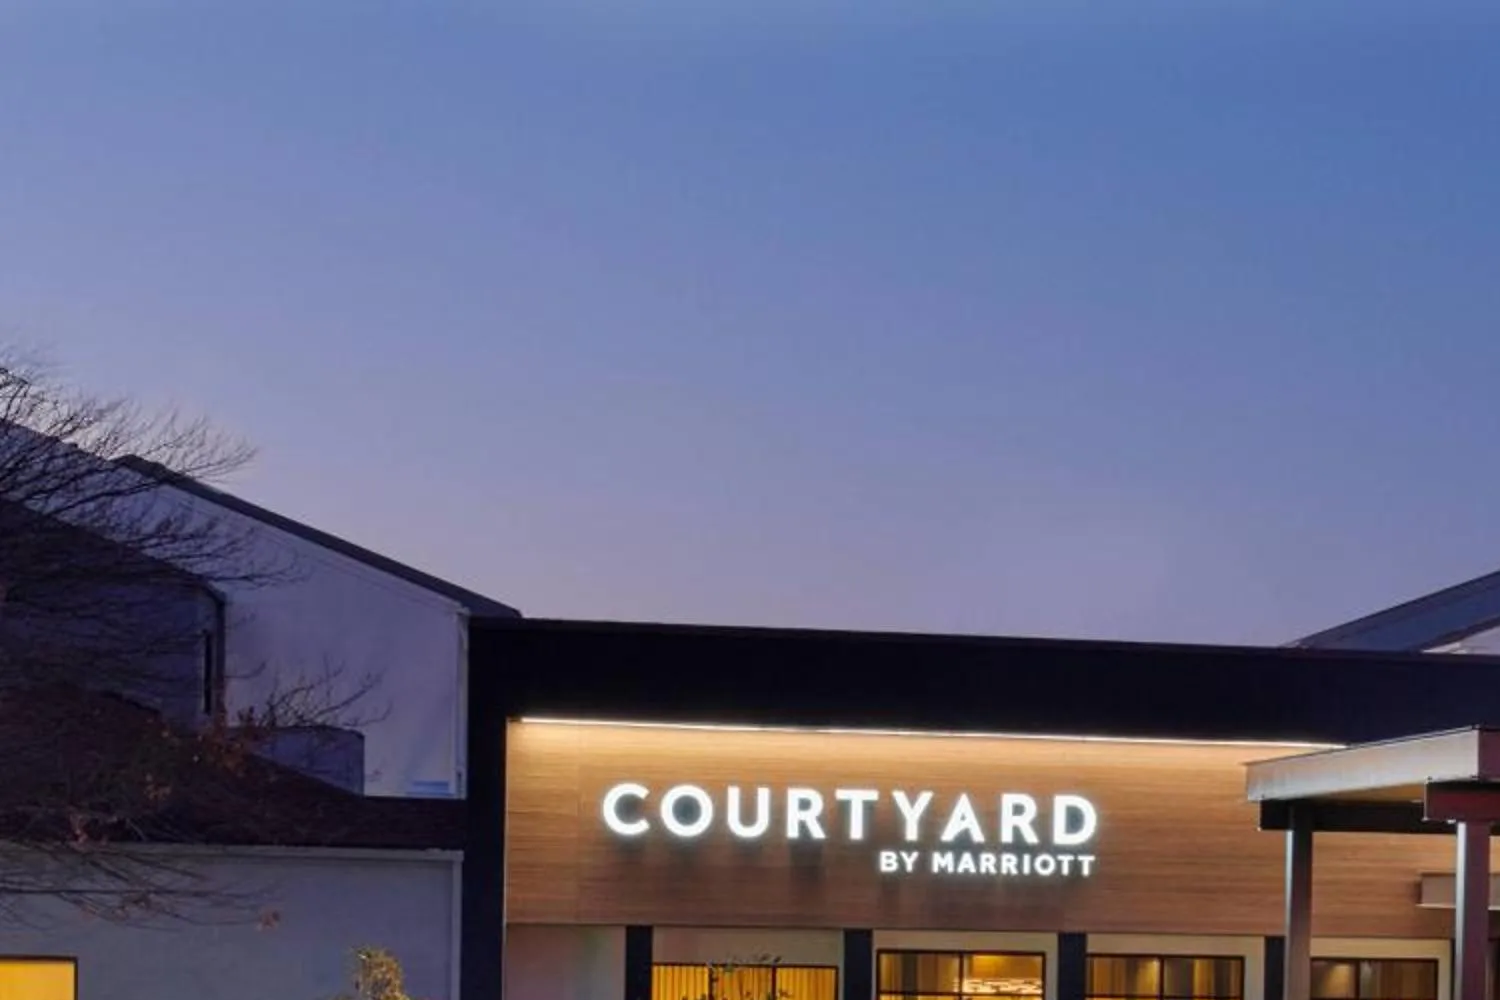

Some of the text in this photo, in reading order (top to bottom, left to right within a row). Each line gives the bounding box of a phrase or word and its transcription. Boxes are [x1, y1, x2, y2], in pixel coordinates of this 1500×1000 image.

[602, 783, 1097, 845] COURTYARD
[879, 851, 1096, 876] BY MARRIOTT
